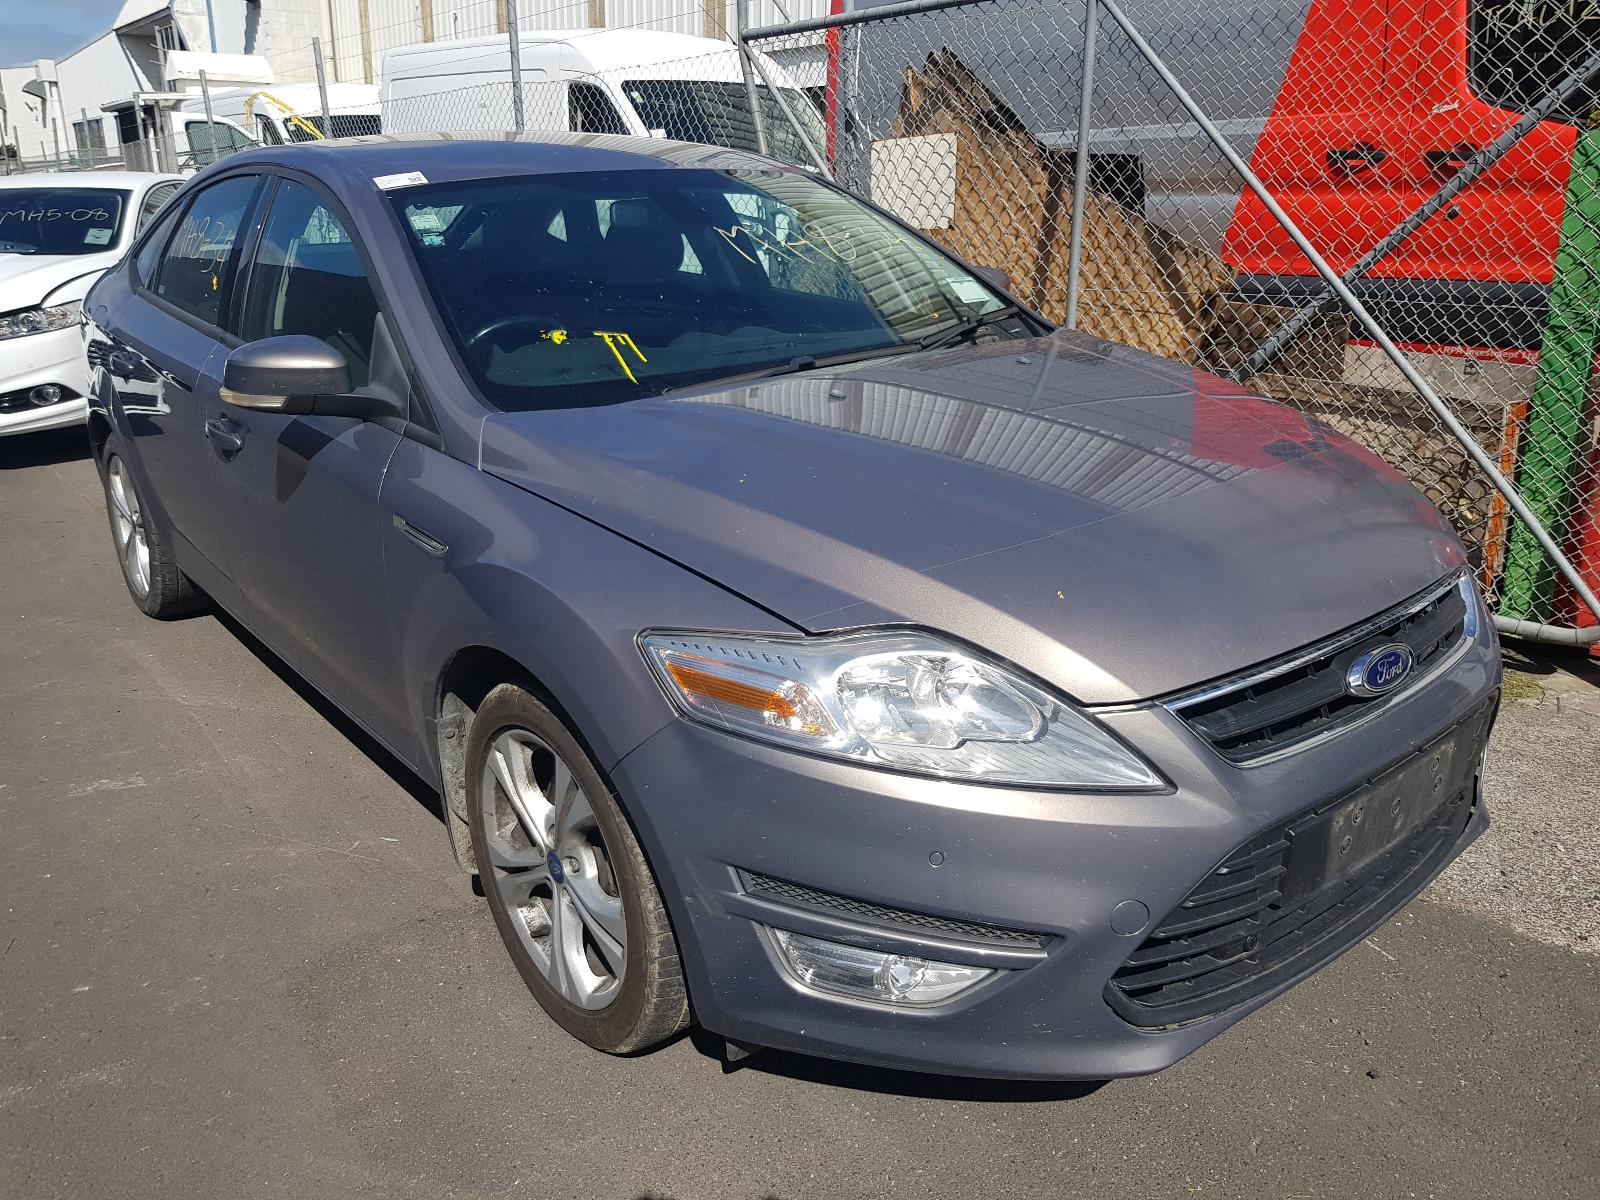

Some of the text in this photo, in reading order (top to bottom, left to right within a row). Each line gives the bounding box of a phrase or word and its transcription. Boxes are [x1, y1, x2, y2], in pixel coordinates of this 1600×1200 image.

[0, 208, 109, 224] MH5-08
[1443, 346, 1463, 355] RPA
[1466, 347, 1519, 359] Investment
[1377, 655, 1404, 684] Ford
